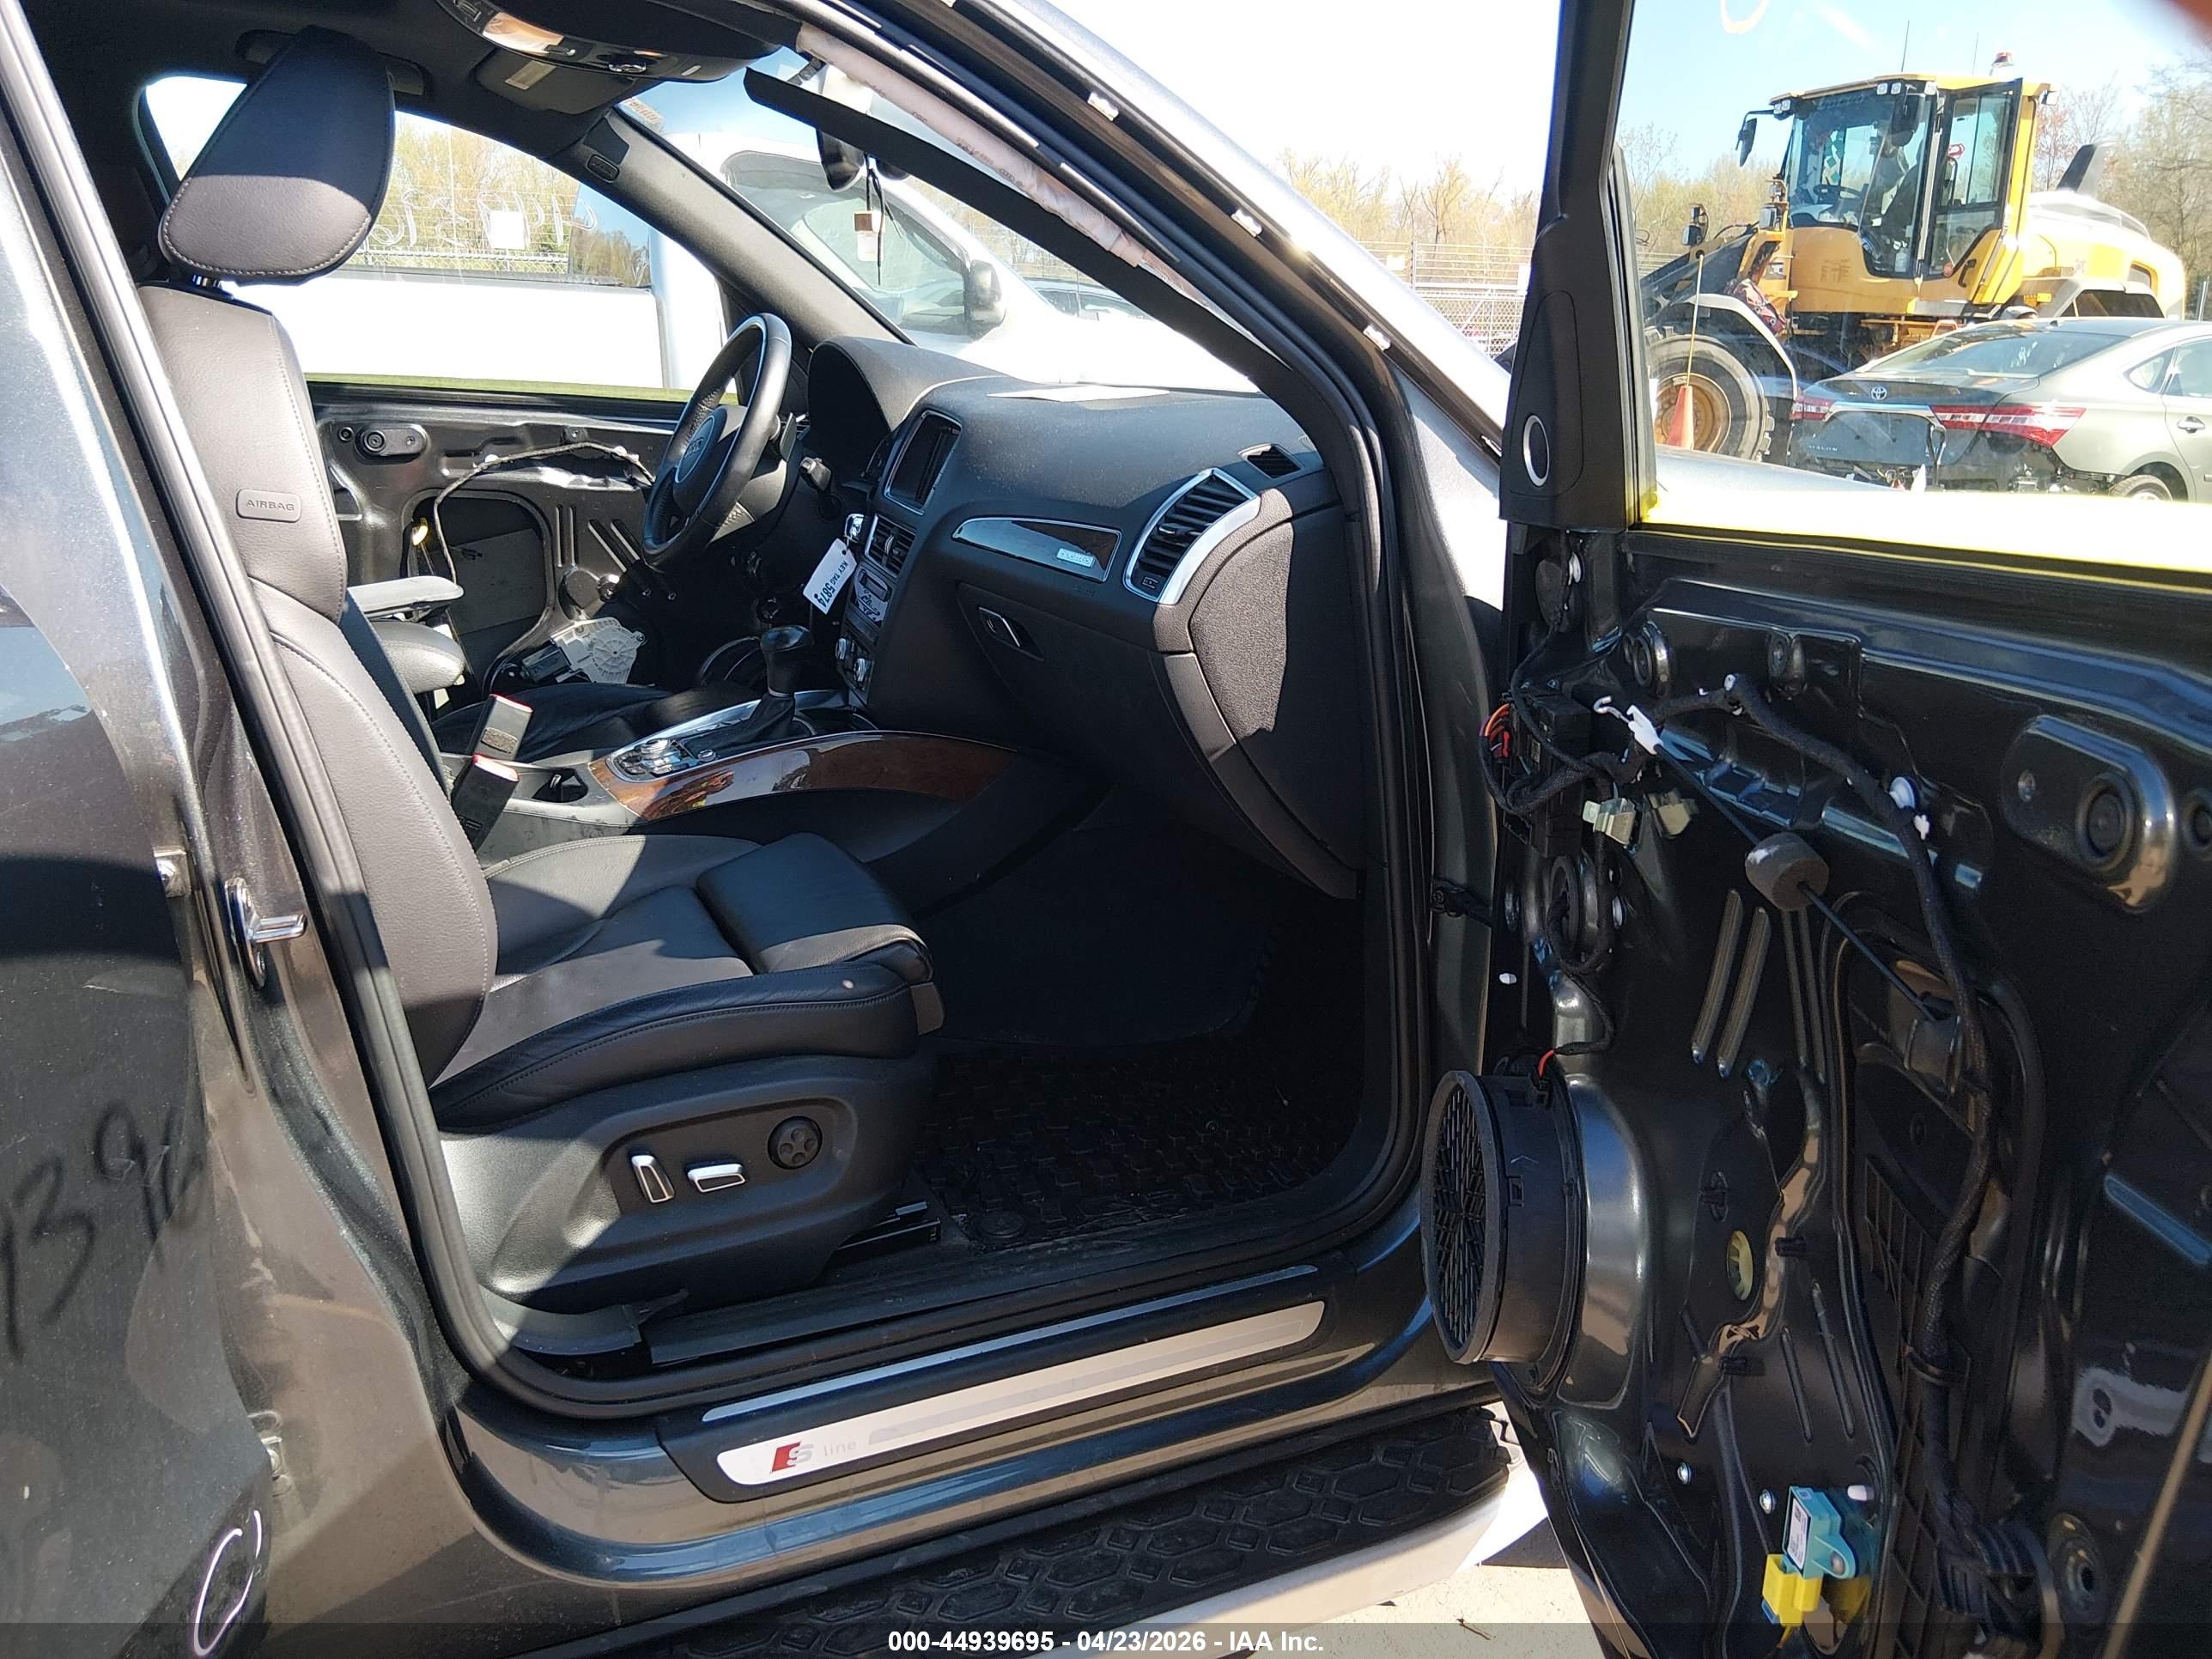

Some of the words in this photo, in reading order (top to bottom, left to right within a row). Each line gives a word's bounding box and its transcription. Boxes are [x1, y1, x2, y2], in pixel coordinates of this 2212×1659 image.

[246, 499, 295, 512] AIRBAG
[837, 560, 849, 574] KEY
[830, 572, 841, 586] TAG
[816, 582, 836, 609] 5874
[784, 1443, 814, 1467] S
[823, 1441, 857, 1457] line
